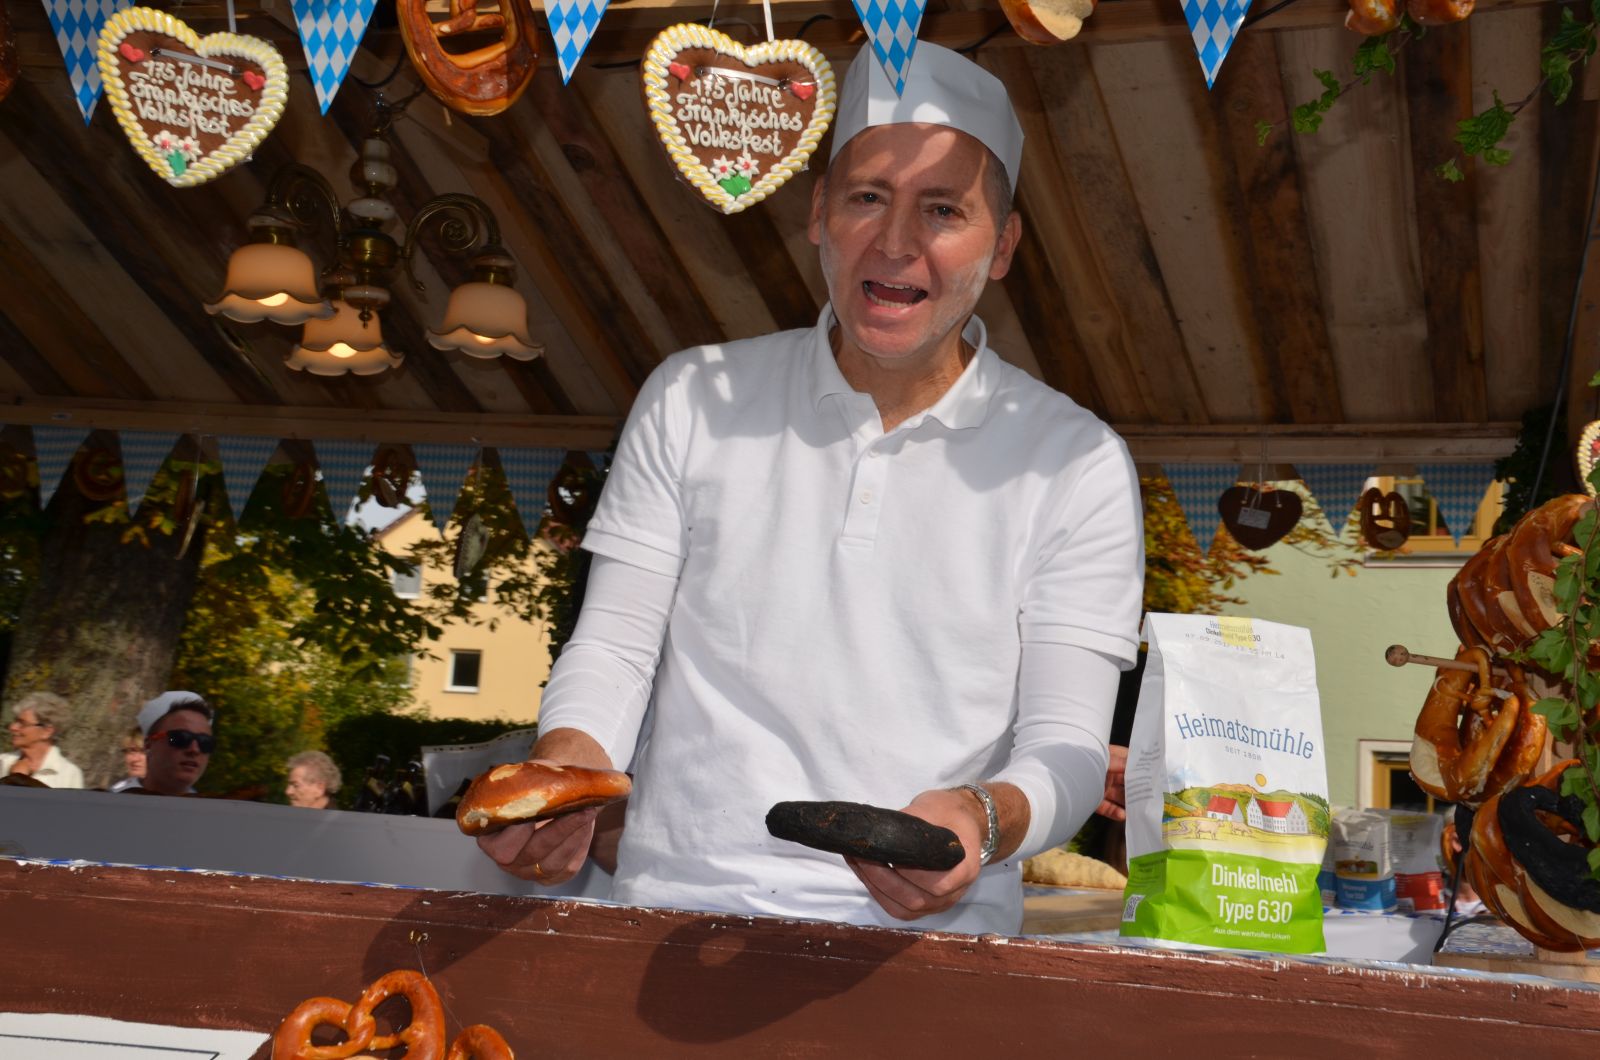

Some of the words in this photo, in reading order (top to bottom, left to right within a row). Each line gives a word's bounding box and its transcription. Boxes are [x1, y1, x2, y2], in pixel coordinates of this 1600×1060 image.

[128, 70, 254, 118] Fränkisches
[142, 60, 176, 82] 175
[175, 61, 238, 94] Jahre
[690, 76, 726, 100] 175
[725, 77, 786, 109] Jahre
[134, 97, 233, 139] Volksfest
[676, 93, 803, 132] Fränkisches
[684, 122, 783, 159] Volksfest
[1248, 634, 1261, 643] 630
[1174, 713, 1314, 760] Heimatsmühle
[1225, 745, 1241, 757] SEIT
[1211, 863, 1299, 894] Dinkelmehl
[1216, 894, 1254, 925] Type
[1257, 899, 1293, 924] 630
